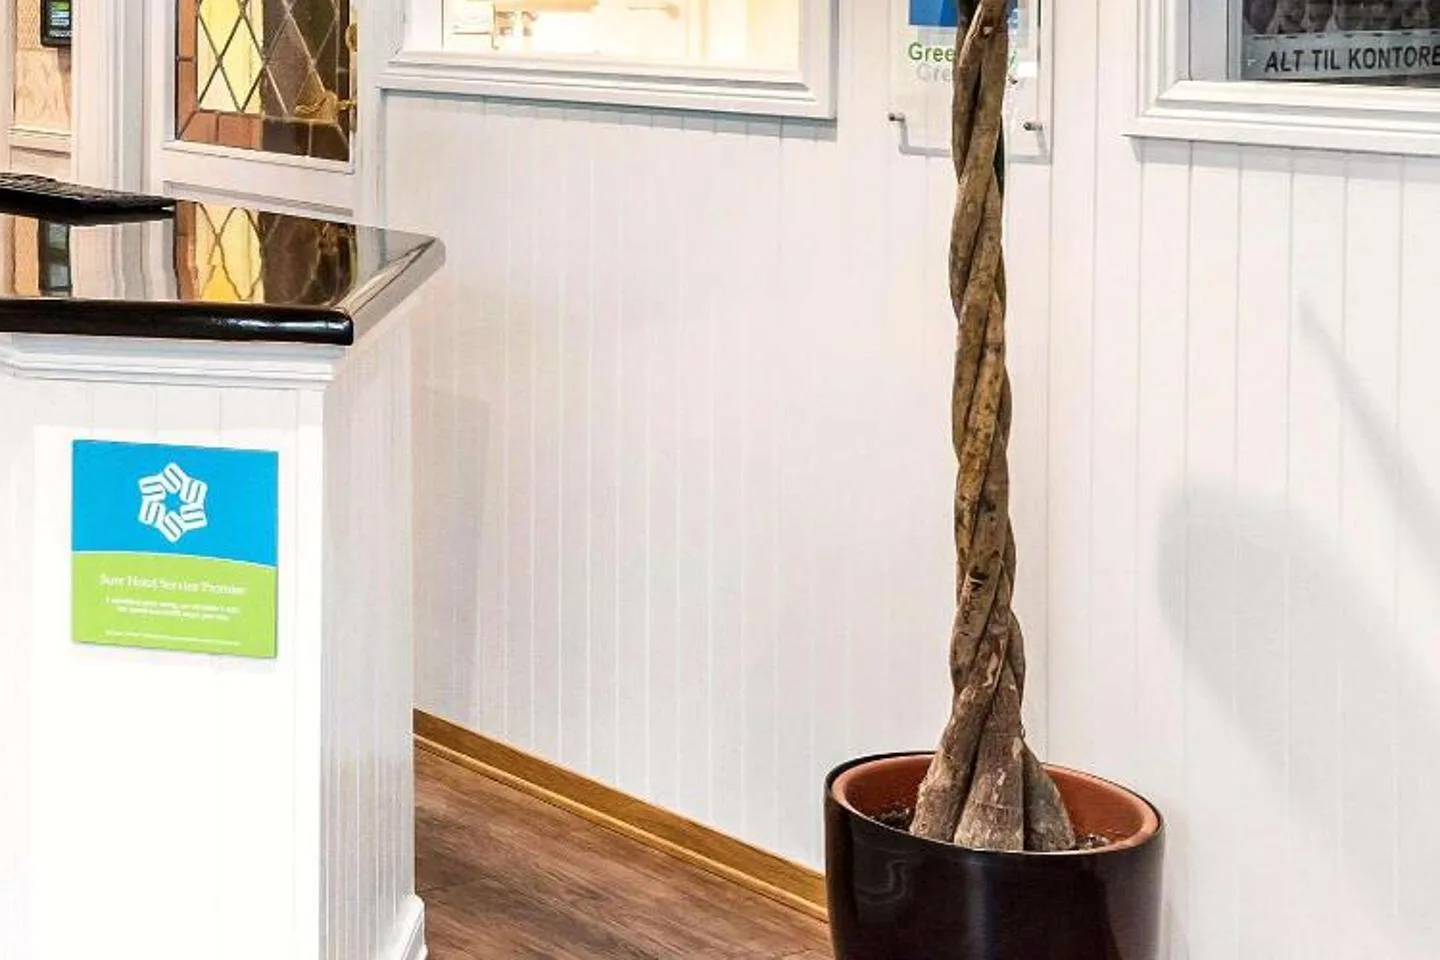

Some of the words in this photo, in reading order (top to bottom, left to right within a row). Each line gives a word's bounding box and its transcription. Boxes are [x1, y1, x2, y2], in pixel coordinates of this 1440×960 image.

[908, 42, 957, 62] Gree
[1264, 50, 1304, 72] ALT
[1312, 49, 1340, 71] TIL
